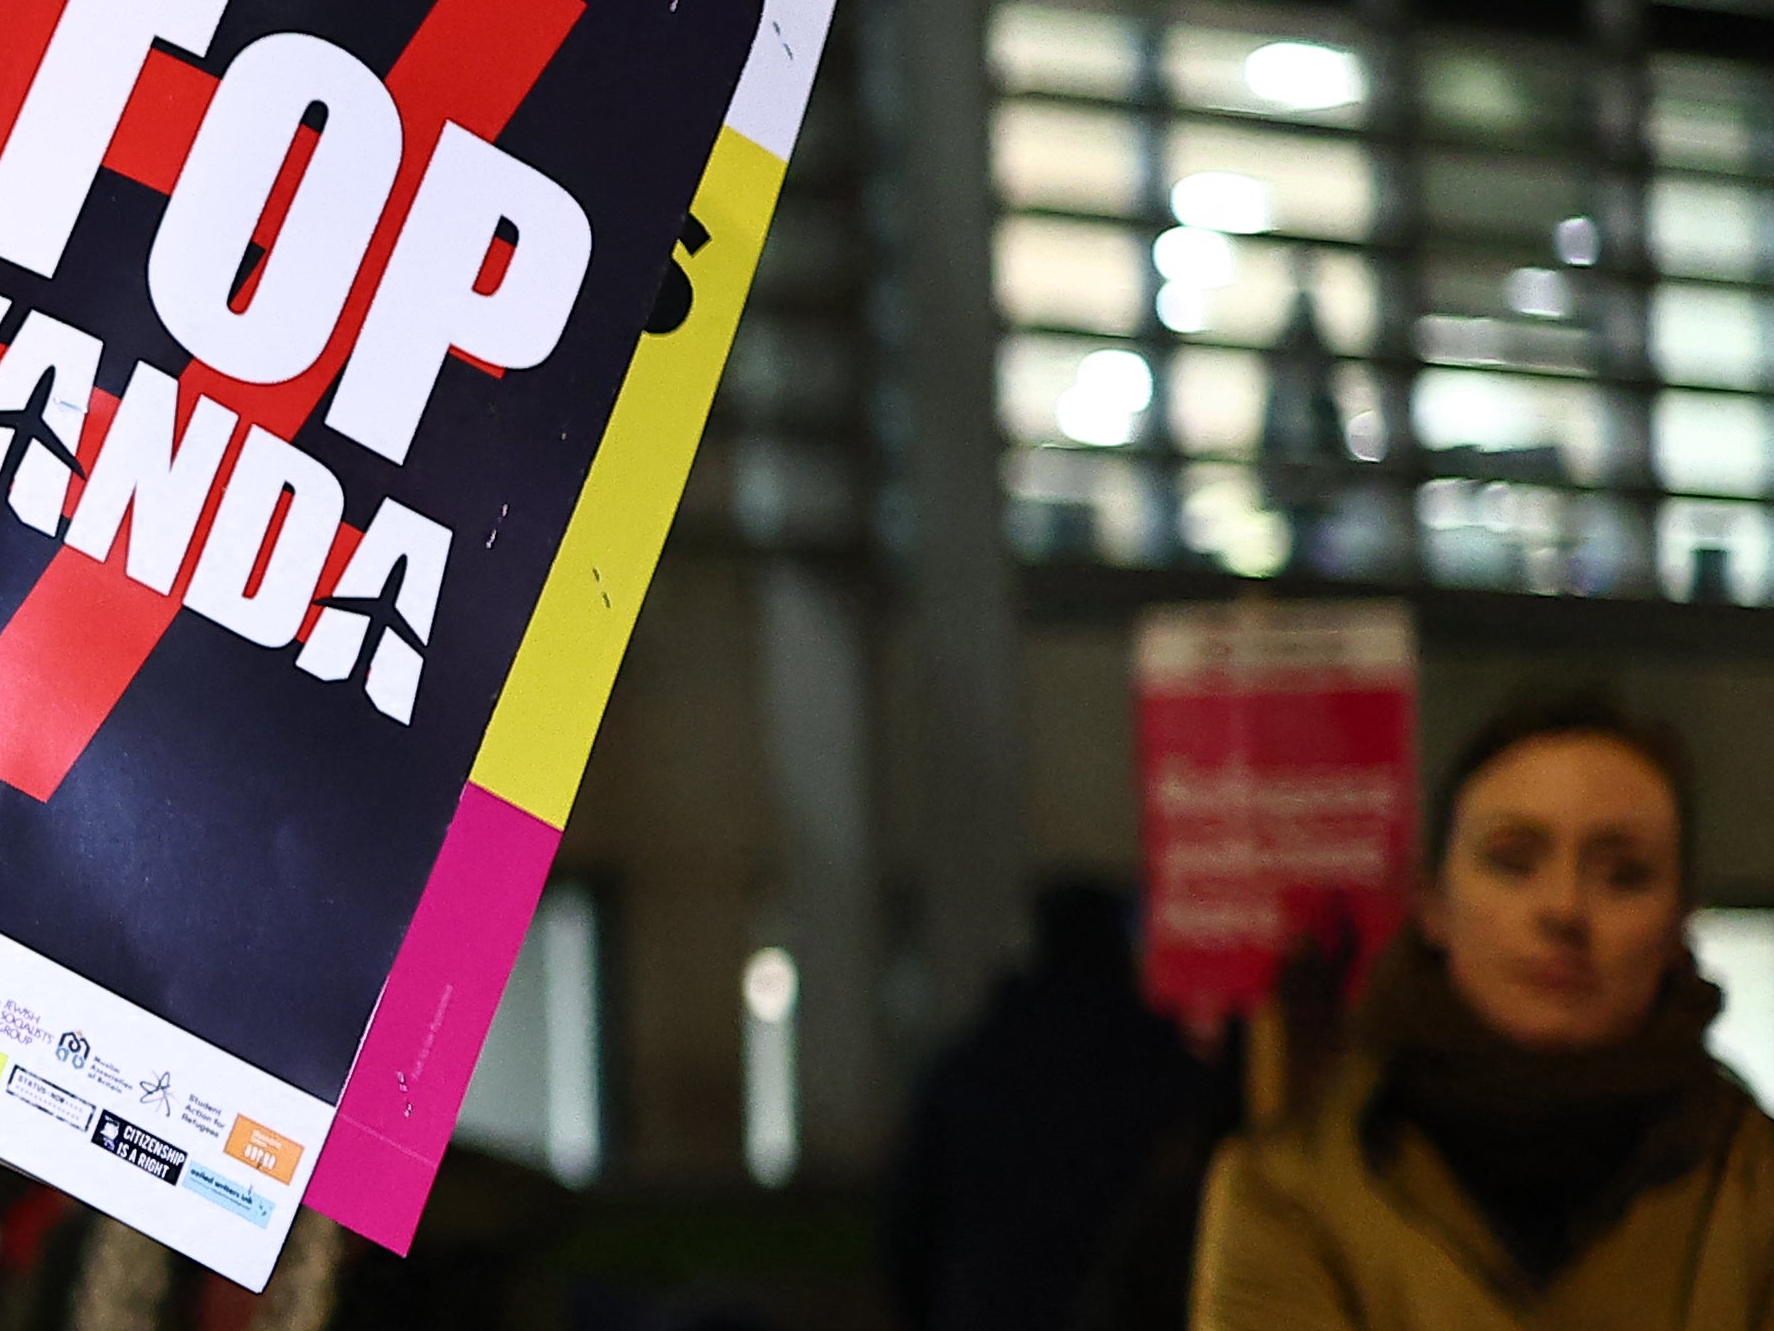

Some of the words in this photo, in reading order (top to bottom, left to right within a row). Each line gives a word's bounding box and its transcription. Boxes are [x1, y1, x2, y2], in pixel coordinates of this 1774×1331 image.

[3, 998, 42, 1024] JEWISH
[184, 1103, 212, 1124] Action
[211, 1116, 227, 1130] for
[188, 1093, 223, 1117] Student
[181, 1112, 220, 1139] Refugees
[123, 1125, 186, 1167] CITIZENSHIP
[116, 1141, 130, 1159] IS
[129, 1148, 138, 1165] A
[137, 1152, 171, 1180] RIGHT
